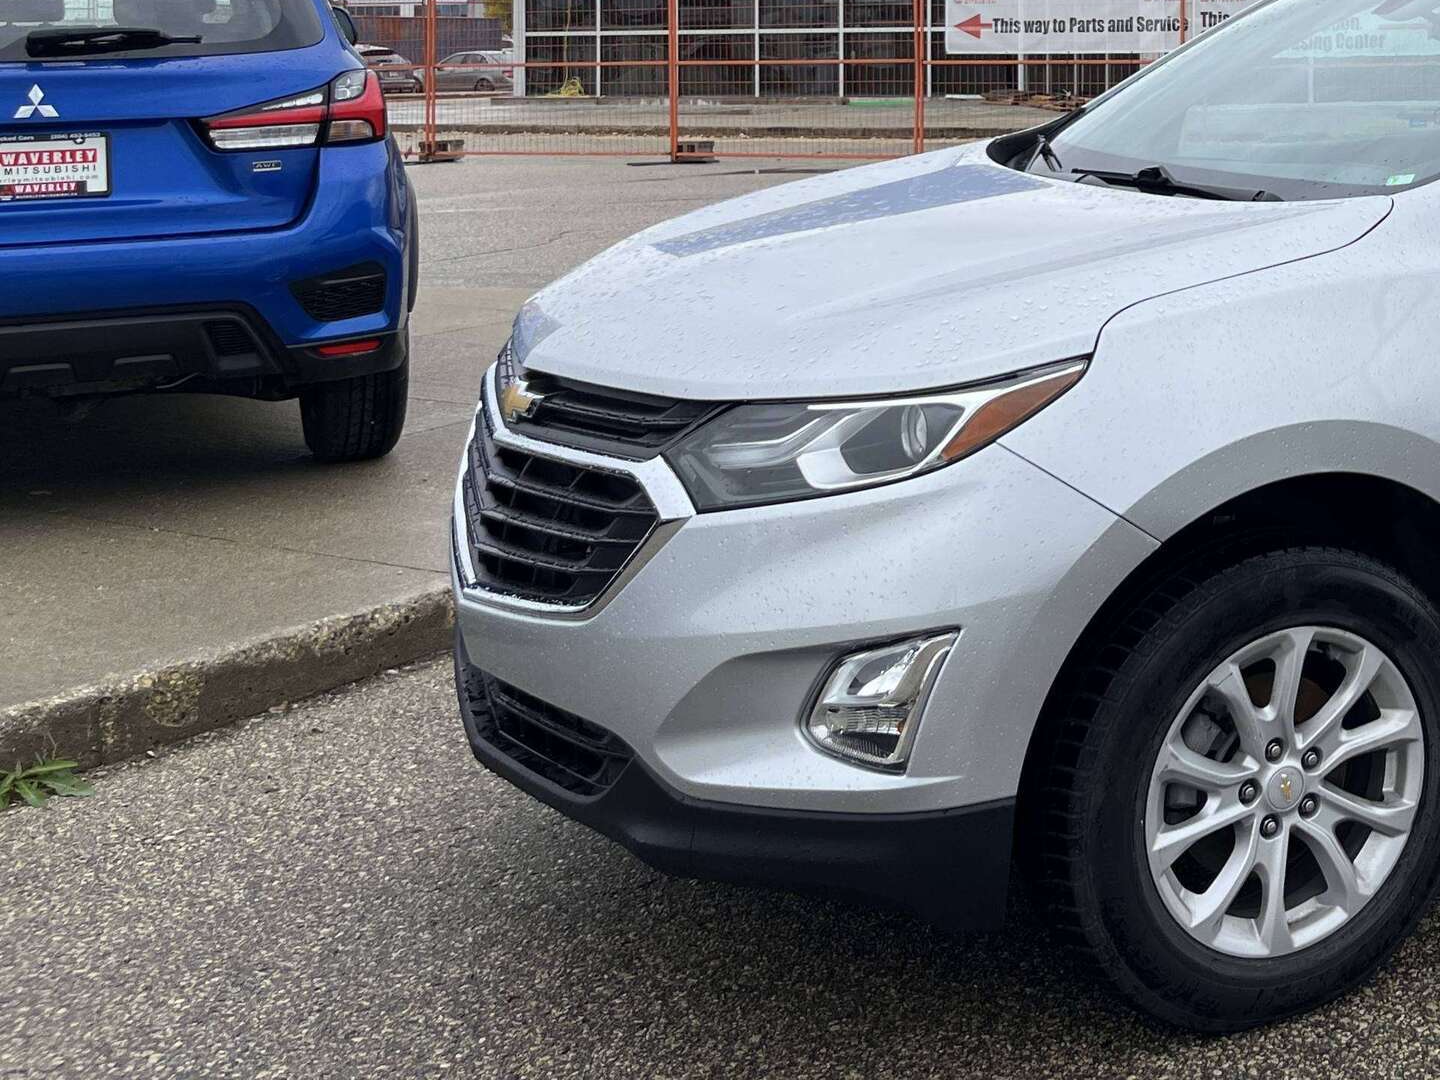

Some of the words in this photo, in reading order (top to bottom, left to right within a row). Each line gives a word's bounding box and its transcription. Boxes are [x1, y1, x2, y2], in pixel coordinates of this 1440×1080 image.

[993, 17, 1021, 34] This
[1023, 20, 1050, 35] way
[1053, 18, 1065, 33] to
[1069, 18, 1105, 33] Parts
[1108, 17, 1134, 33] and
[1136, 16, 1189, 33] Service
[1335, 32, 1385, 49] Center
[1, 150, 96, 165] WAVERLEY
[4, 164, 97, 176] MITSUBISHI
[15, 182, 77, 193] WAVERLEY
